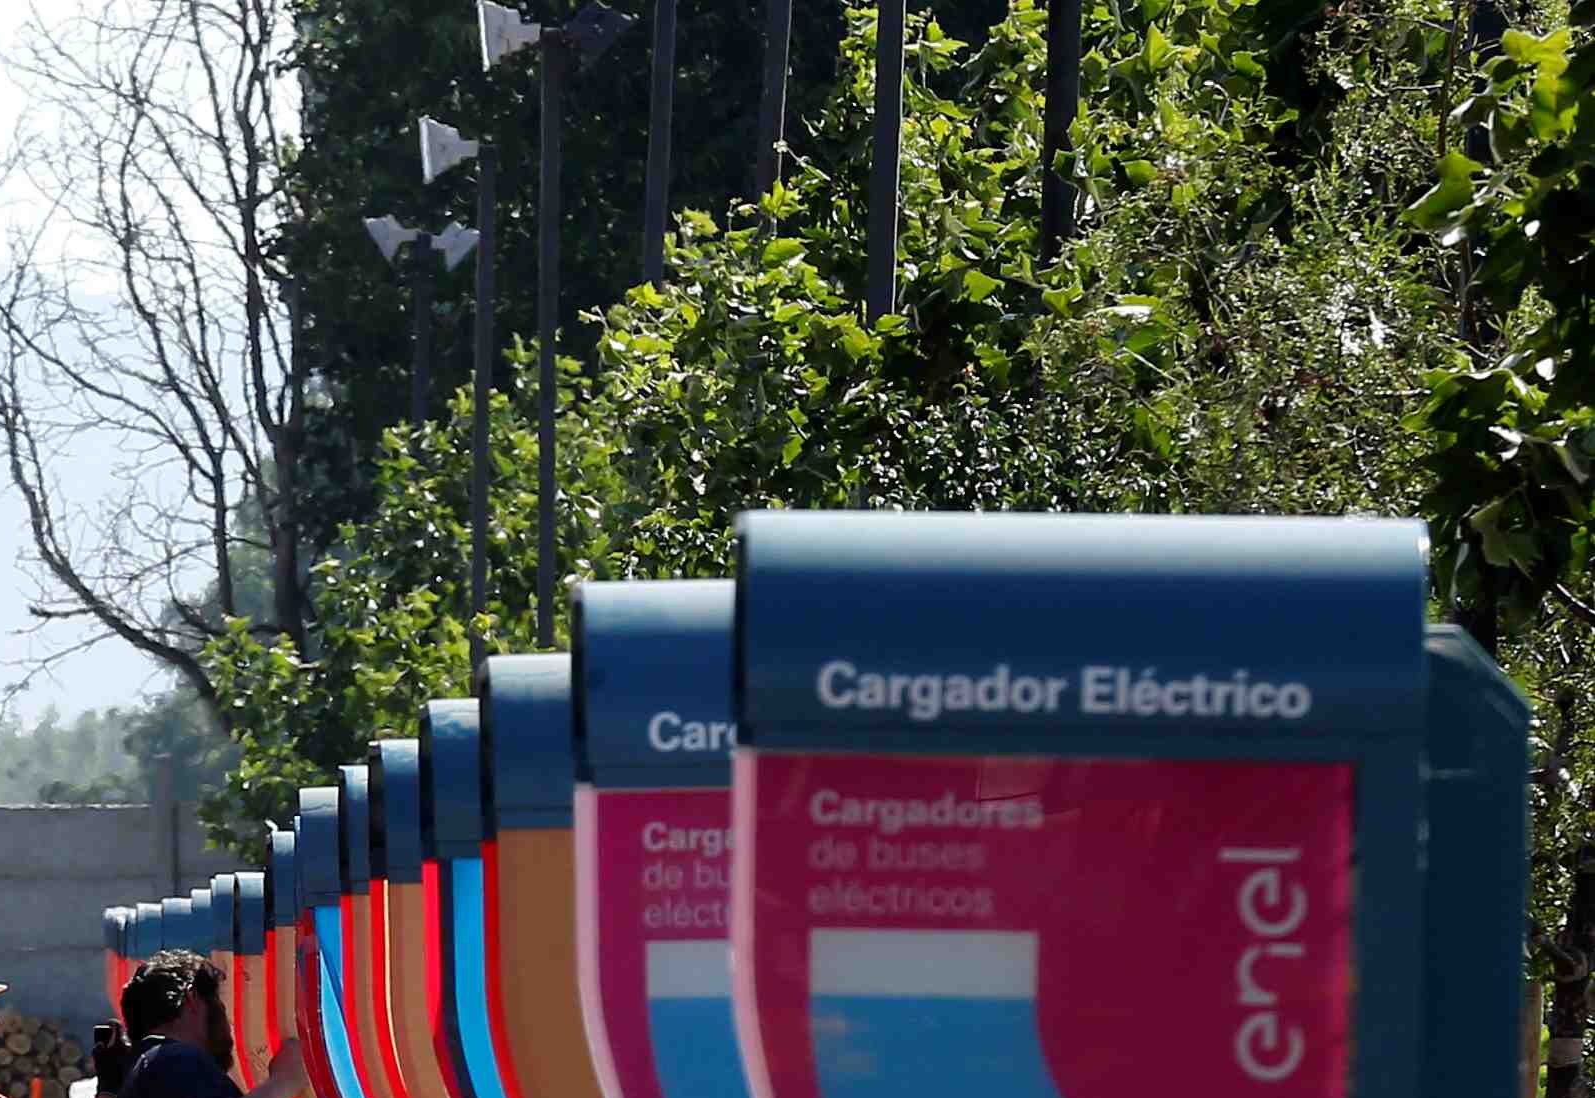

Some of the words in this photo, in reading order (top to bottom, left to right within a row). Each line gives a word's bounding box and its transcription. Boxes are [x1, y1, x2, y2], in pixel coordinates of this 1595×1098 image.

[817, 661, 1067, 720] Cargador
[1080, 666, 1312, 718] Eléctrico
[810, 790, 1044, 835] Cargadores
[809, 837, 857, 869] de
[868, 837, 986, 870] buses
[643, 862, 684, 890] de
[809, 877, 995, 917] eléctricos
[1218, 848, 1306, 1083] enel
